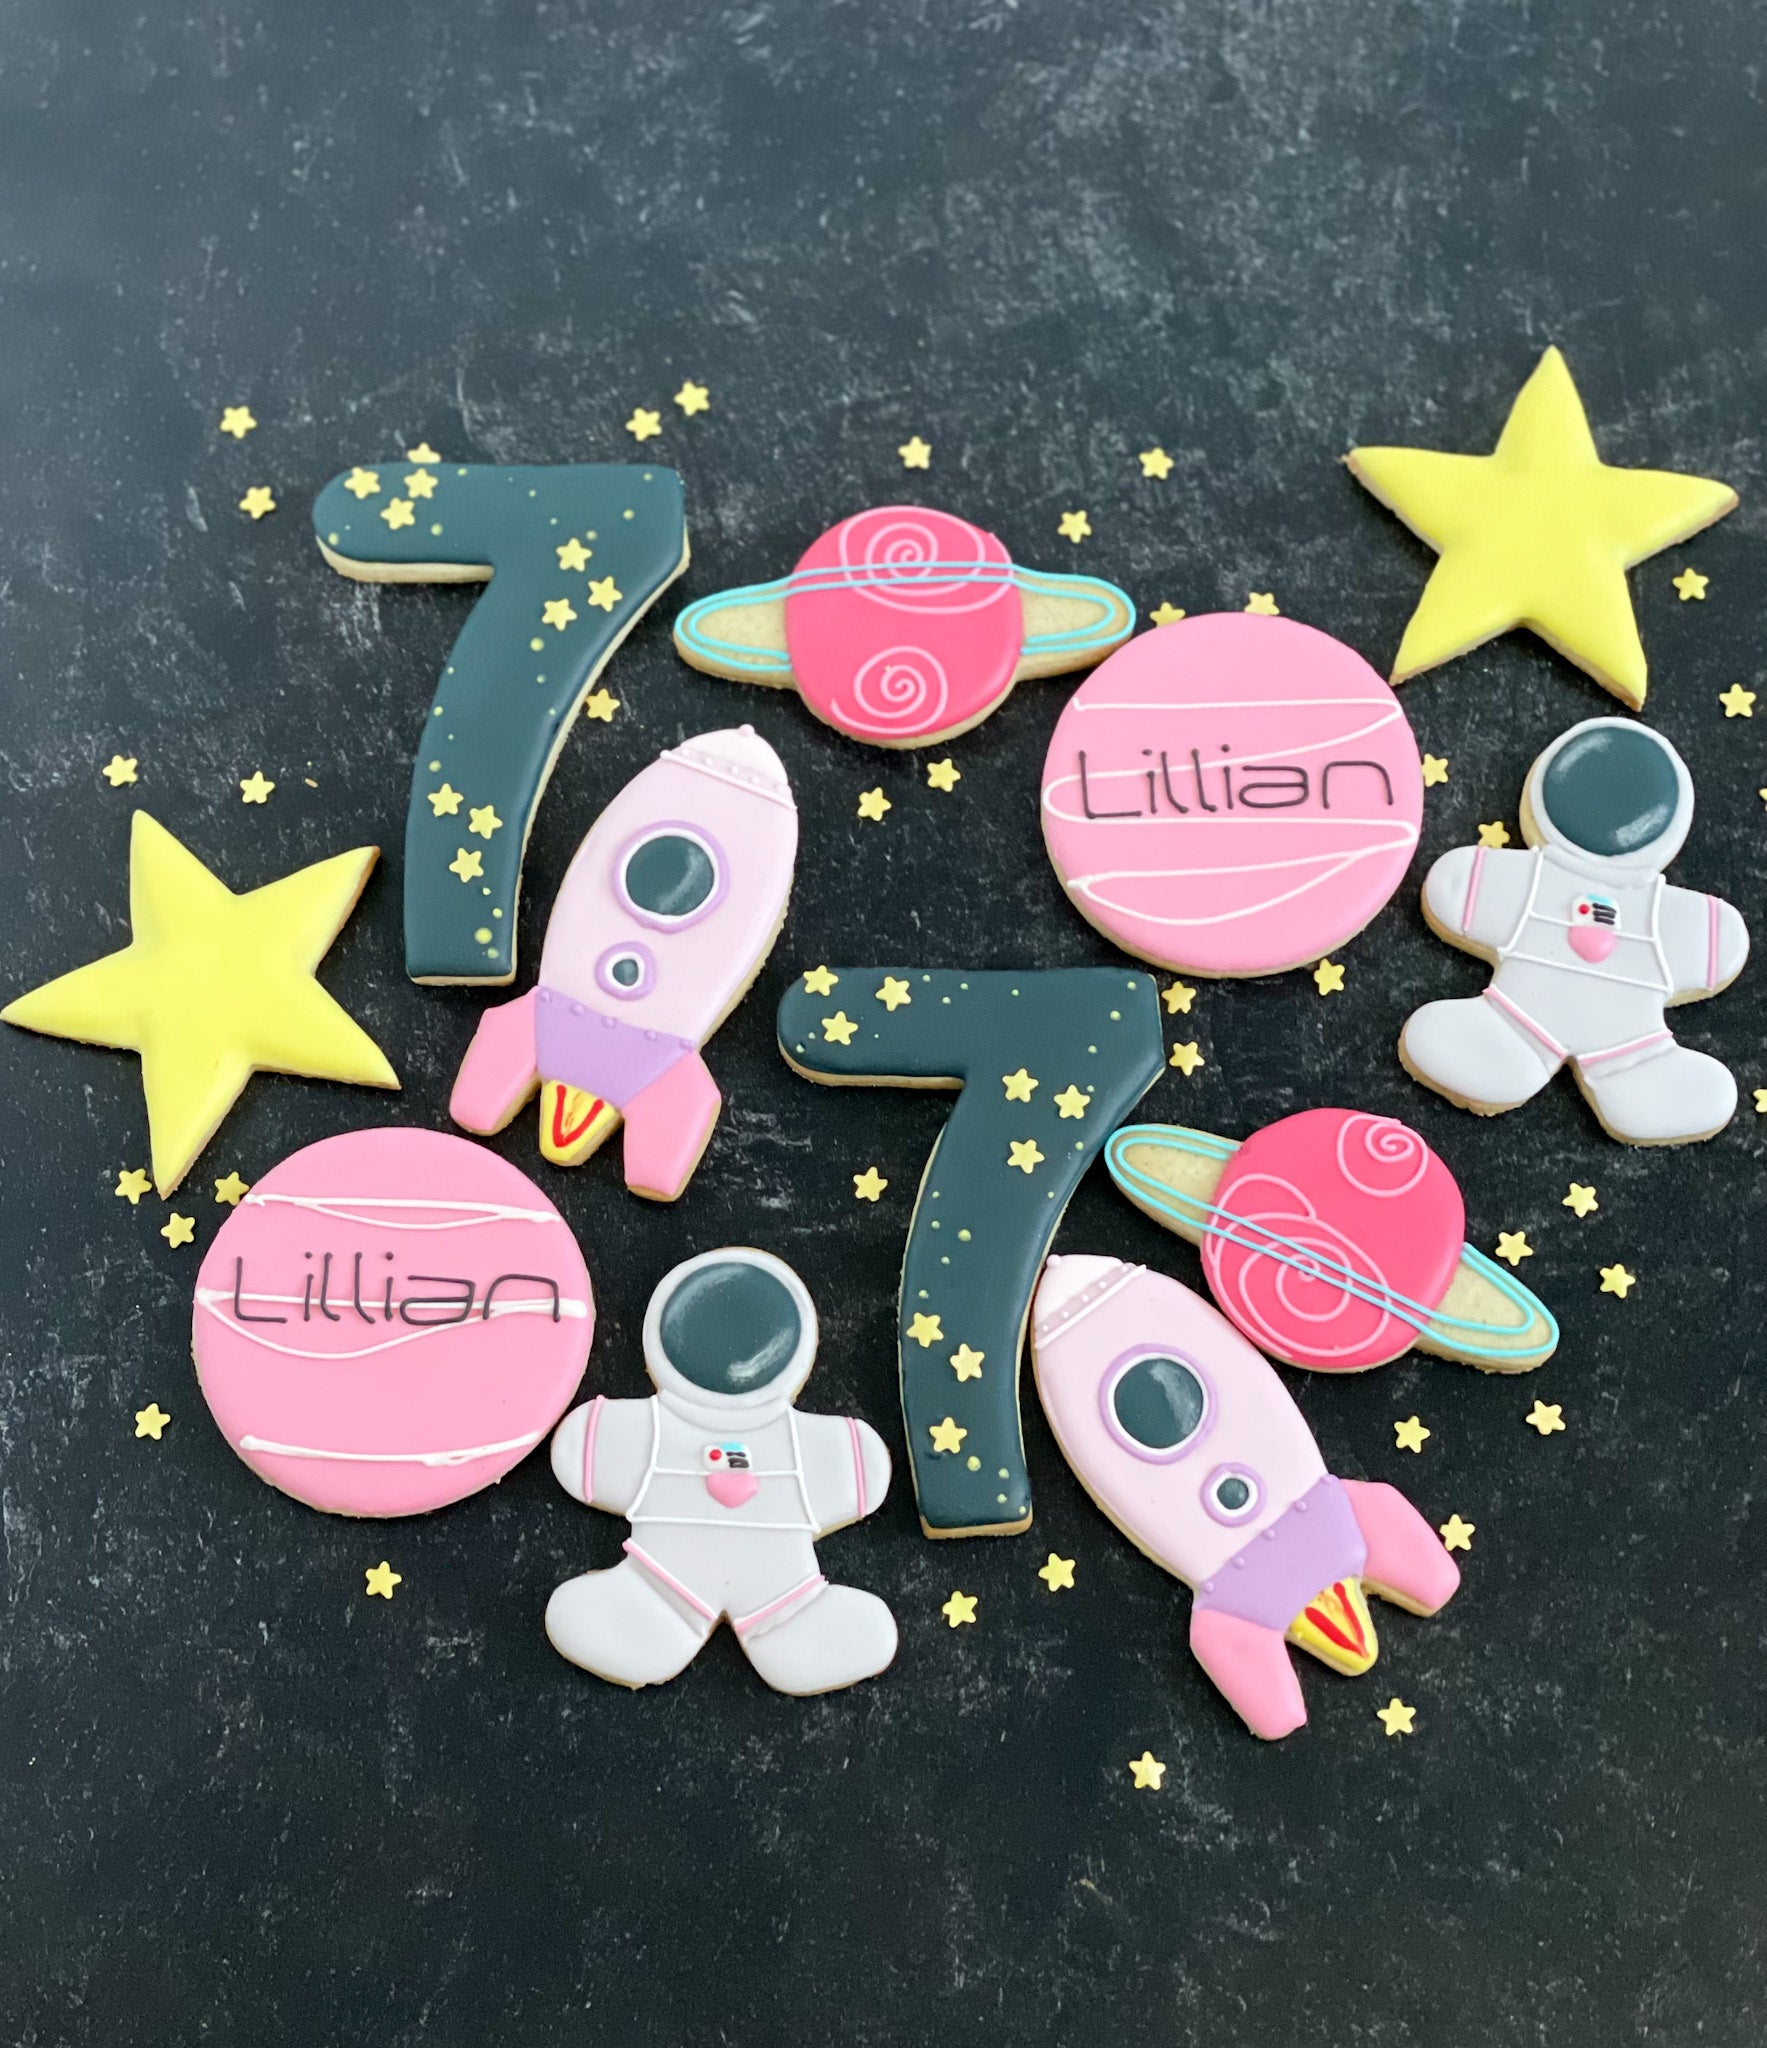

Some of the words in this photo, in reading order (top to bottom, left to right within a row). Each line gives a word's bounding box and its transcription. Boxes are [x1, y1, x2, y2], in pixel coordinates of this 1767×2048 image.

[312, 461, 691, 986] 7
[1078, 743, 1394, 819] Lillian
[234, 1251, 561, 1325] Lillian
[776, 966, 1165, 1539] 7
